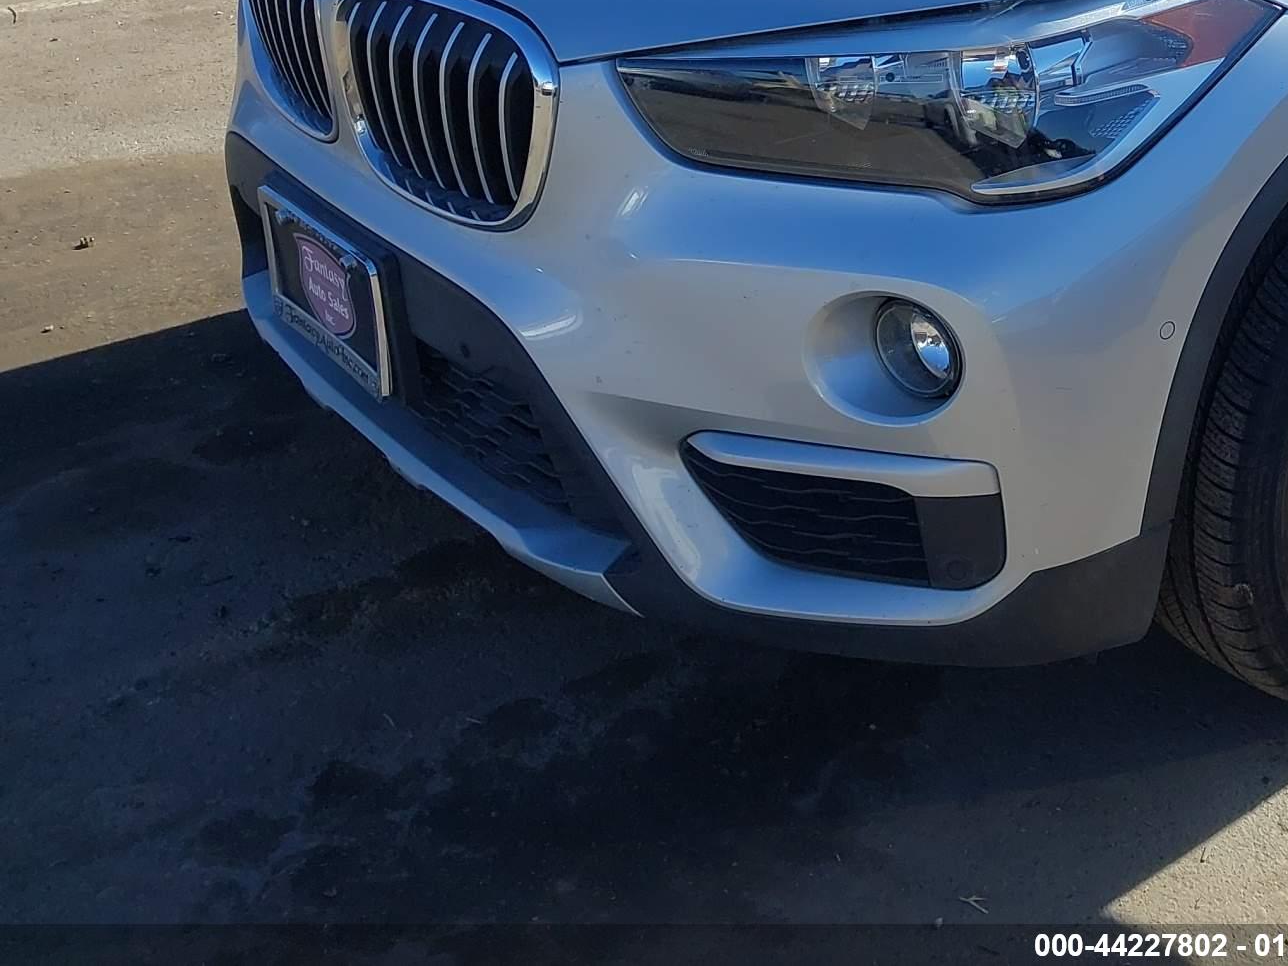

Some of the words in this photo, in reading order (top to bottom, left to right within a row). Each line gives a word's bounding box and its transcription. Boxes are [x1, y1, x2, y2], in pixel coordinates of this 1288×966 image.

[302, 245, 348, 302] Fantasy
[308, 277, 327, 302] Auto
[327, 291, 350, 320] Sales
